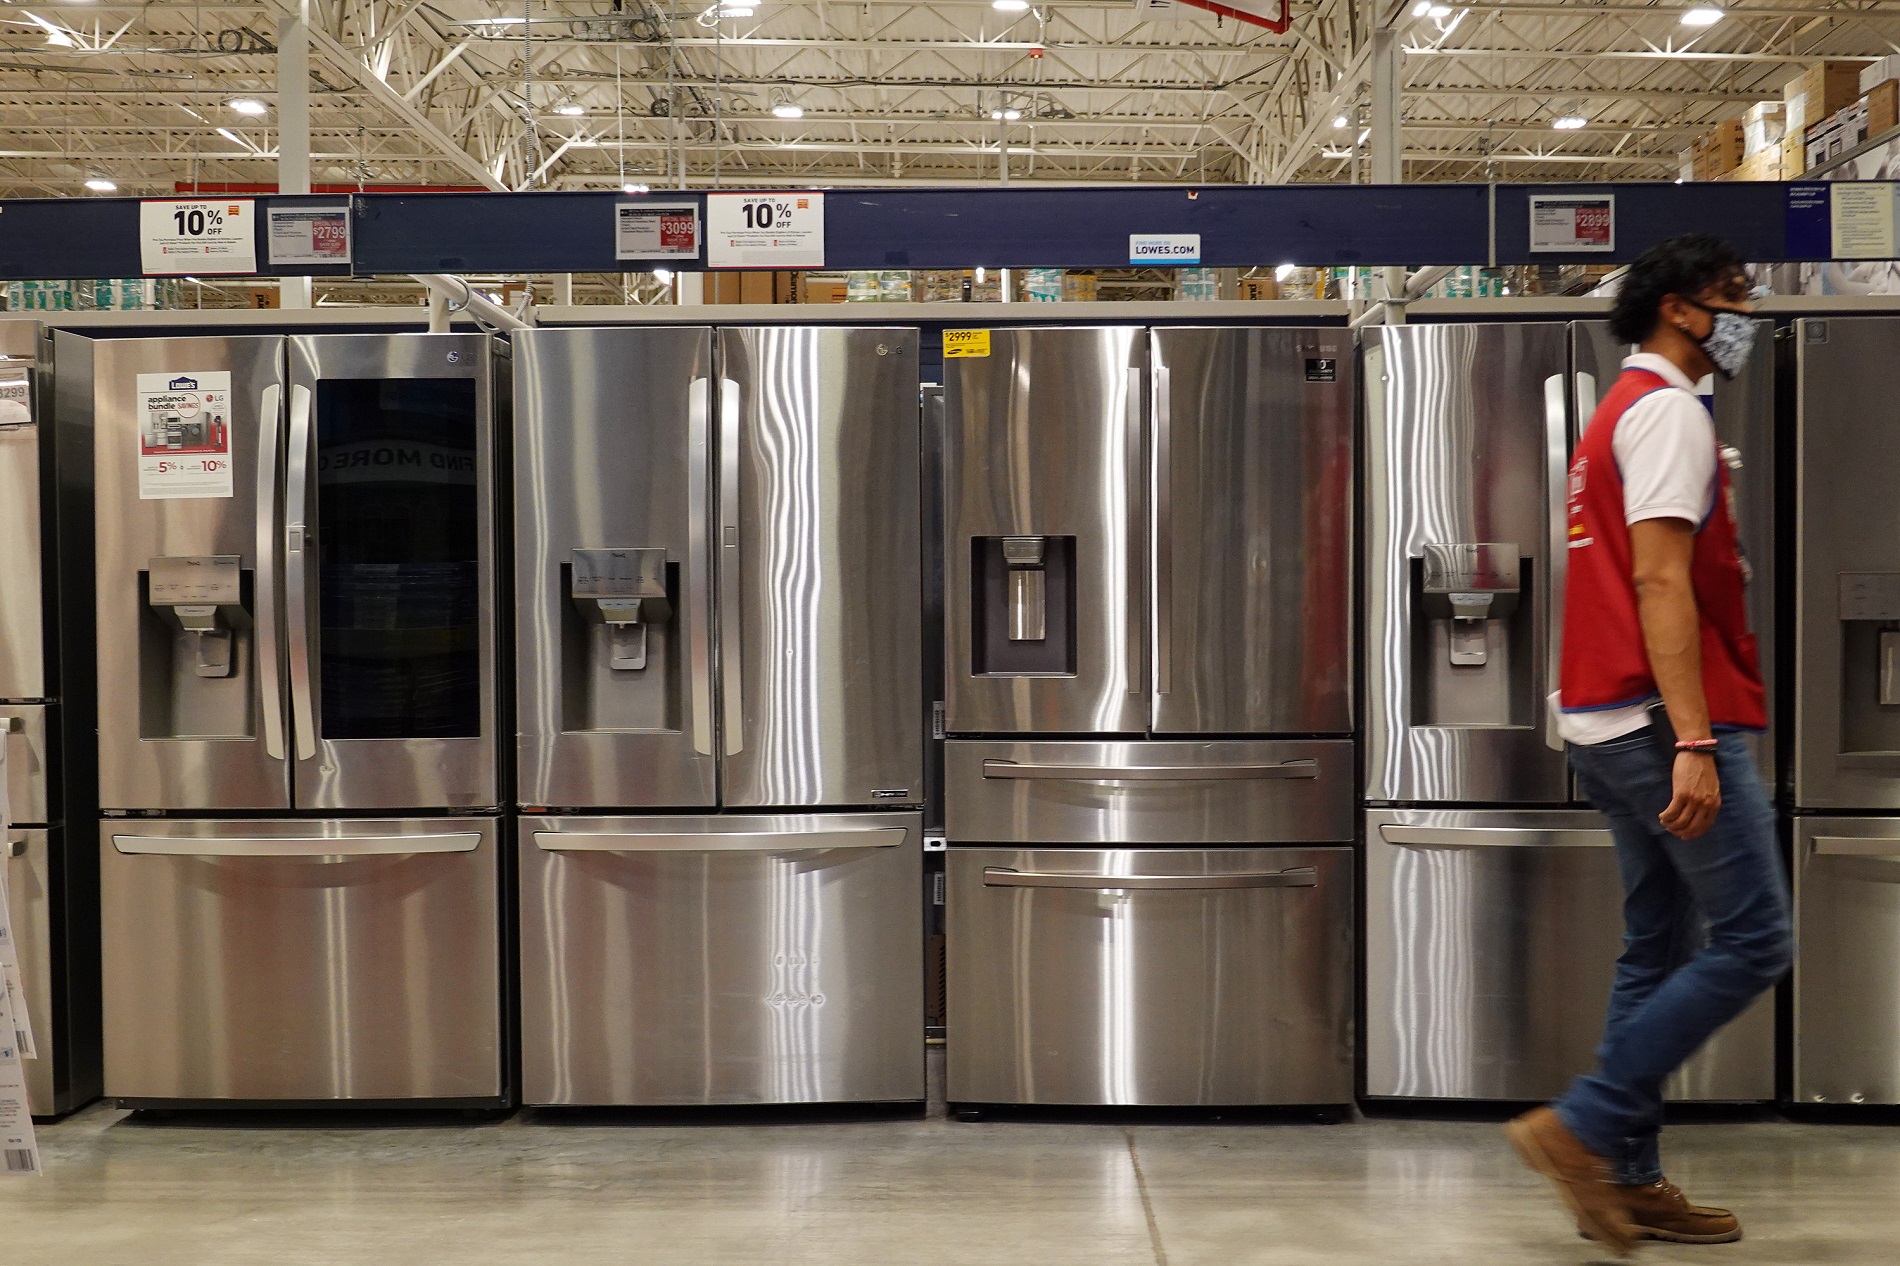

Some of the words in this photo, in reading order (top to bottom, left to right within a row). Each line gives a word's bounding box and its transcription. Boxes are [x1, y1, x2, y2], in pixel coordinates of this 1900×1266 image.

[313, 226, 346, 239] $2799
[661, 222, 694, 235] $3099
[1136, 246, 1195, 254] LOWES.COM
[945, 331, 972, 341] $2999
[148, 395, 186, 404] appliance
[159, 461, 177, 473] 5%
[201, 460, 226, 471] 10%
